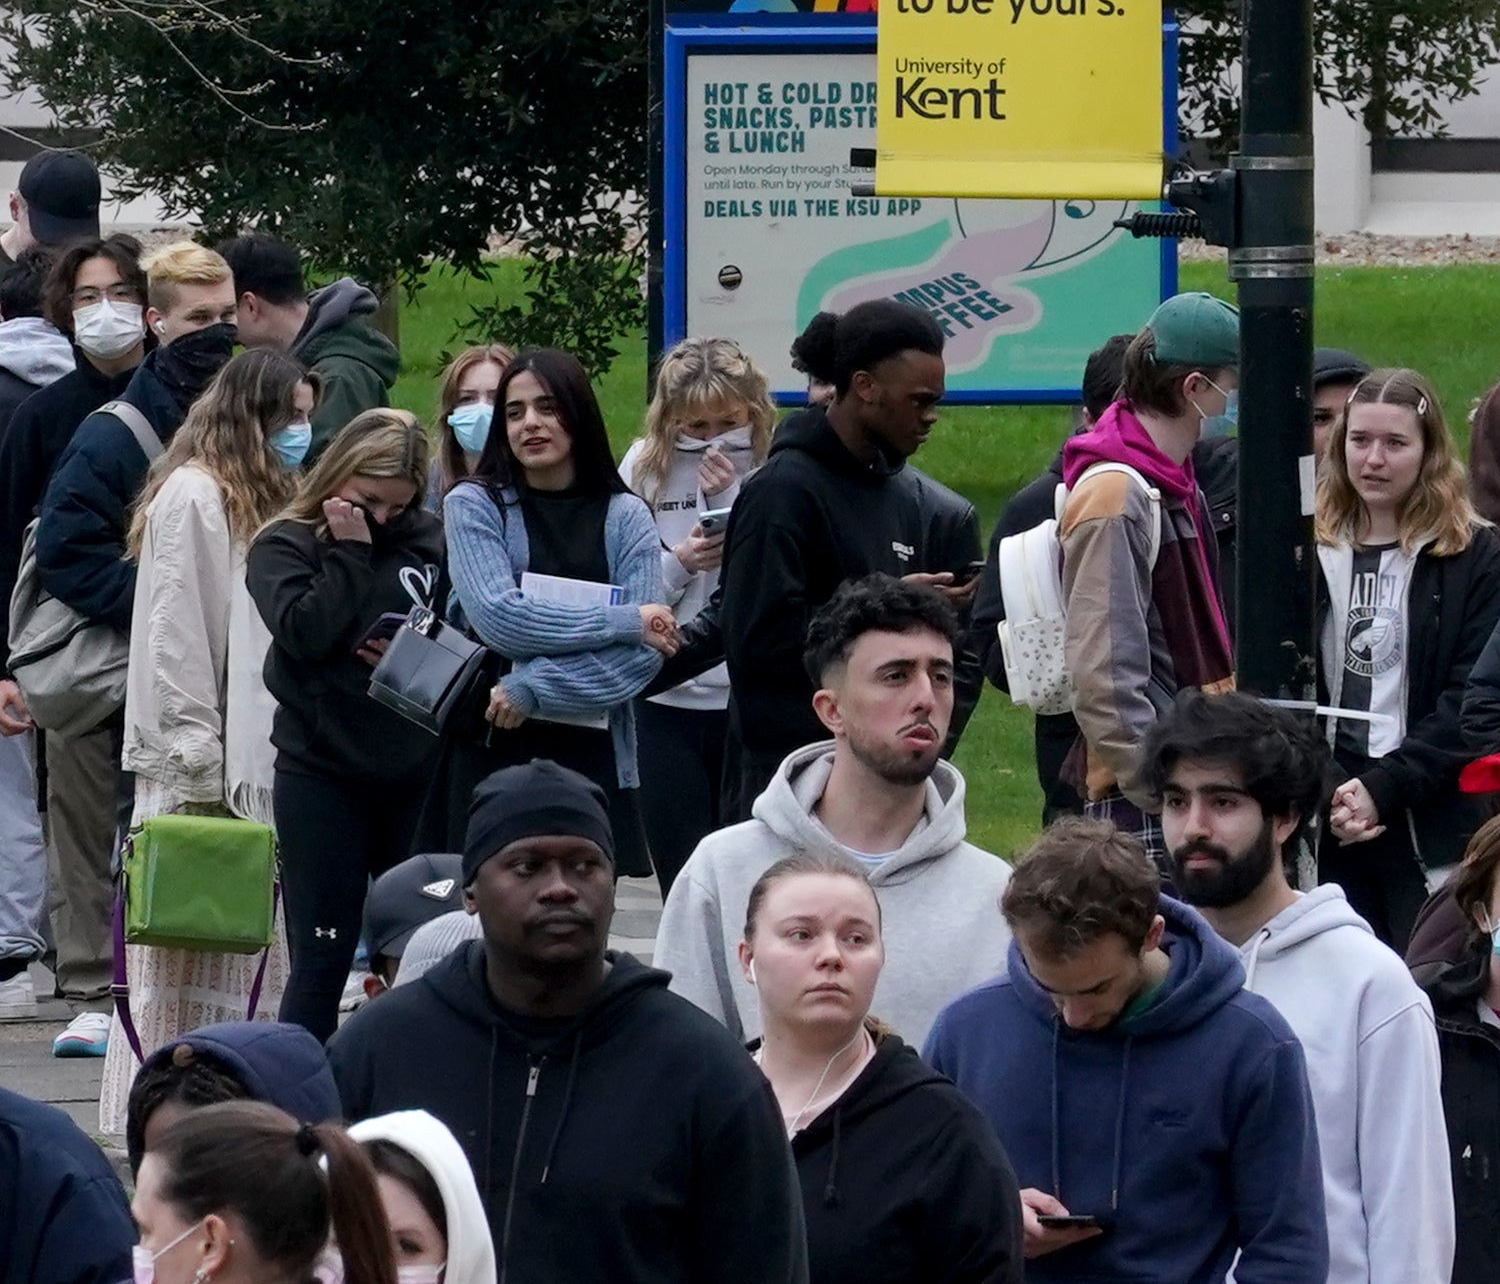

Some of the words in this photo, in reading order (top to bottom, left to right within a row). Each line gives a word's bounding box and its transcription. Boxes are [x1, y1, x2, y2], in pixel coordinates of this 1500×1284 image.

[895, 57, 983, 79] University
[987, 57, 1007, 75] of
[704, 83, 748, 105] HOT
[757, 83, 774, 105] &
[782, 82, 842, 105] COLD
[895, 77, 1006, 120] Kent
[704, 107, 801, 130] SNACKS,
[704, 131, 720, 153] &
[729, 131, 805, 153] LUNCH
[703, 165, 736, 178] Open
[739, 165, 788, 178] Monday
[791, 164, 839, 178] through
[704, 179, 730, 190] until
[732, 179, 759, 190] late.
[761, 180, 784, 190] Run
[786, 179, 801, 192] by
[804, 181, 832, 192] your
[704, 200, 763, 218] DEALS
[769, 200, 798, 217] VIA
[804, 199, 839, 217] THE
[846, 199, 880, 217] KSU
[887, 199, 922, 217] APP
[893, 272, 981, 309] MPUS
